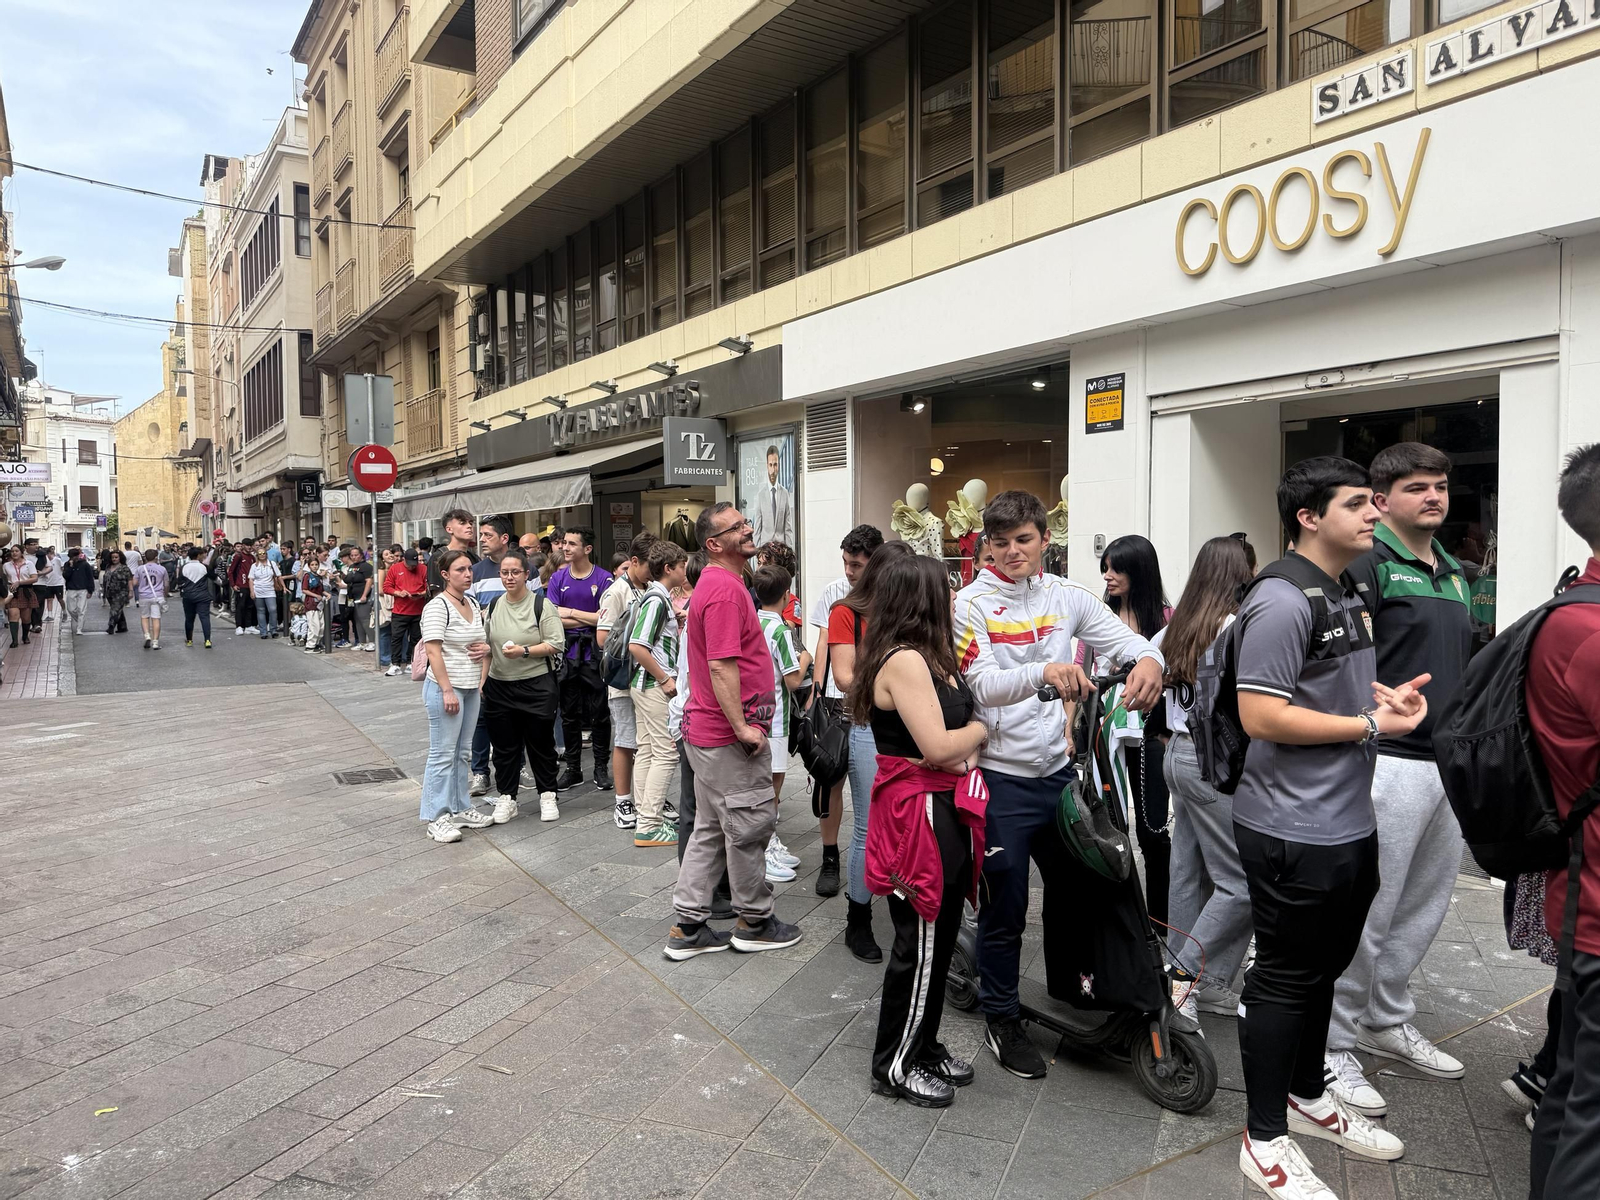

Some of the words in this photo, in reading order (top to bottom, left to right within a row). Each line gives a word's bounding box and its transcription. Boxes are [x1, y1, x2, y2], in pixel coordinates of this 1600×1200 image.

[1319, 58, 1407, 116] SAN
[1430, 0, 1600, 76] ALVA
[1175, 127, 1432, 277] coosy
[576, 379, 700, 434] FABRICANTES
[1090, 395, 1120, 404] CONECTADA
[674, 467, 723, 476] FABRICANTES
